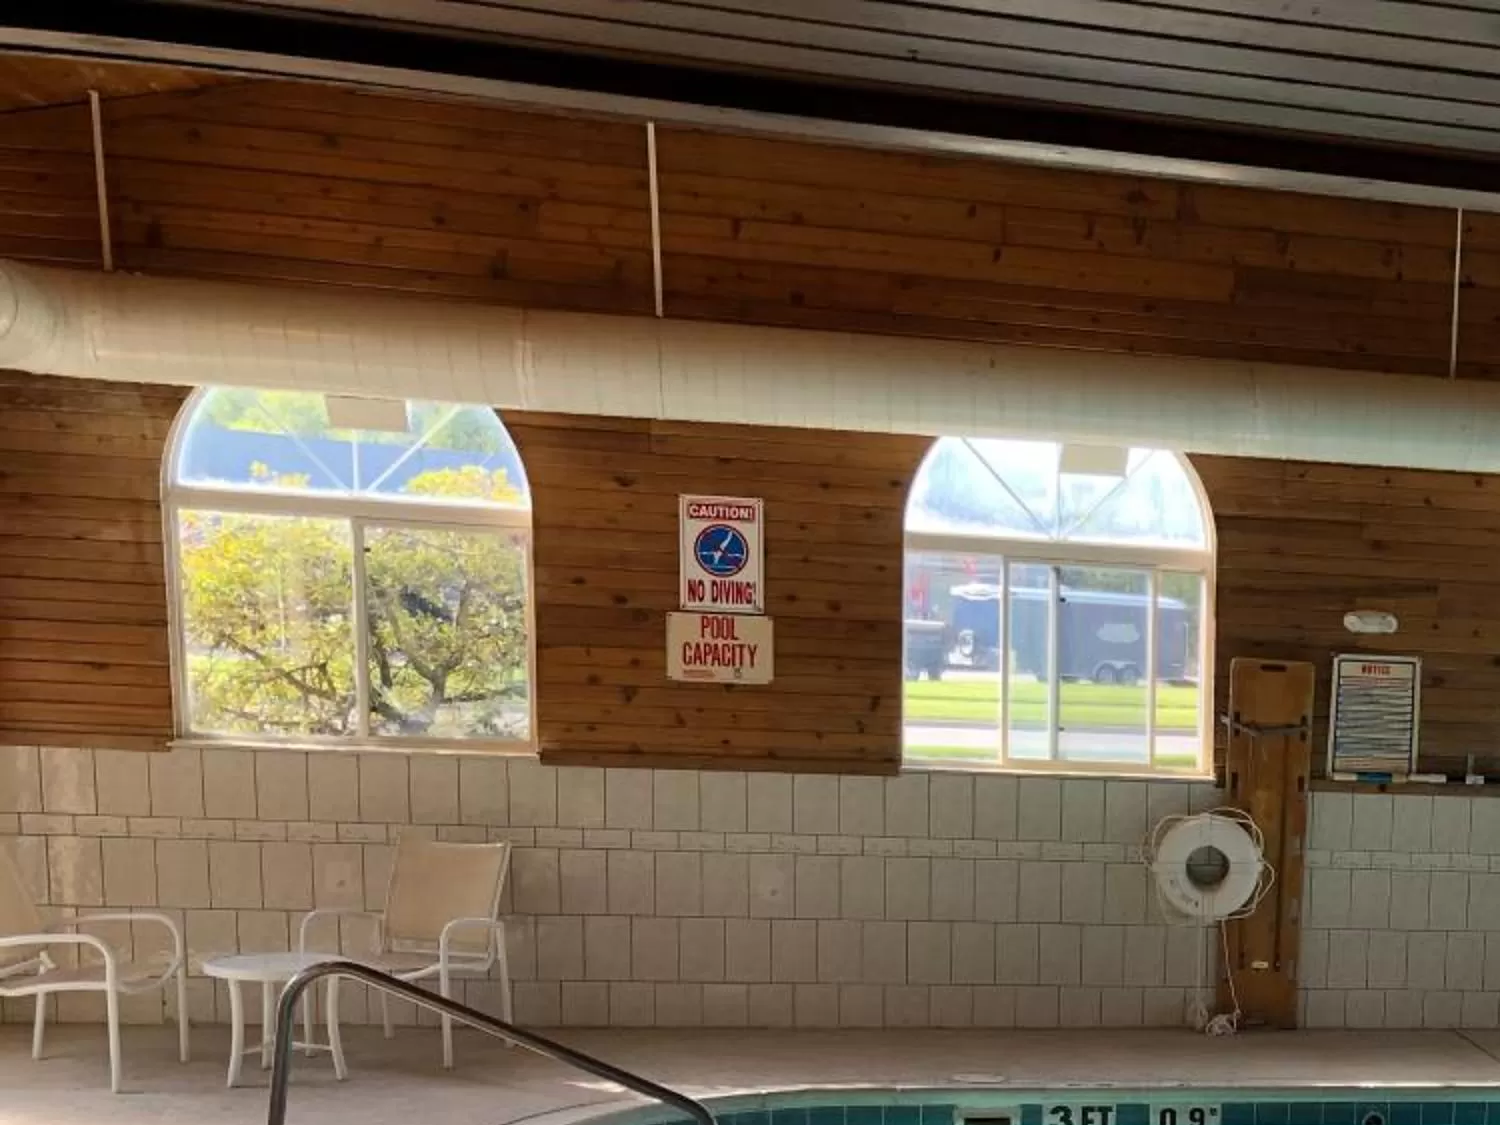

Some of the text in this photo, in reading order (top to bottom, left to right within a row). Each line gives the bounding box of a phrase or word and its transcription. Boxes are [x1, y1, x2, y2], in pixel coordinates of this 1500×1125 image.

[688, 579, 705, 602] NO
[701, 616, 738, 640] POOL
[683, 641, 758, 668] CAPACITY
